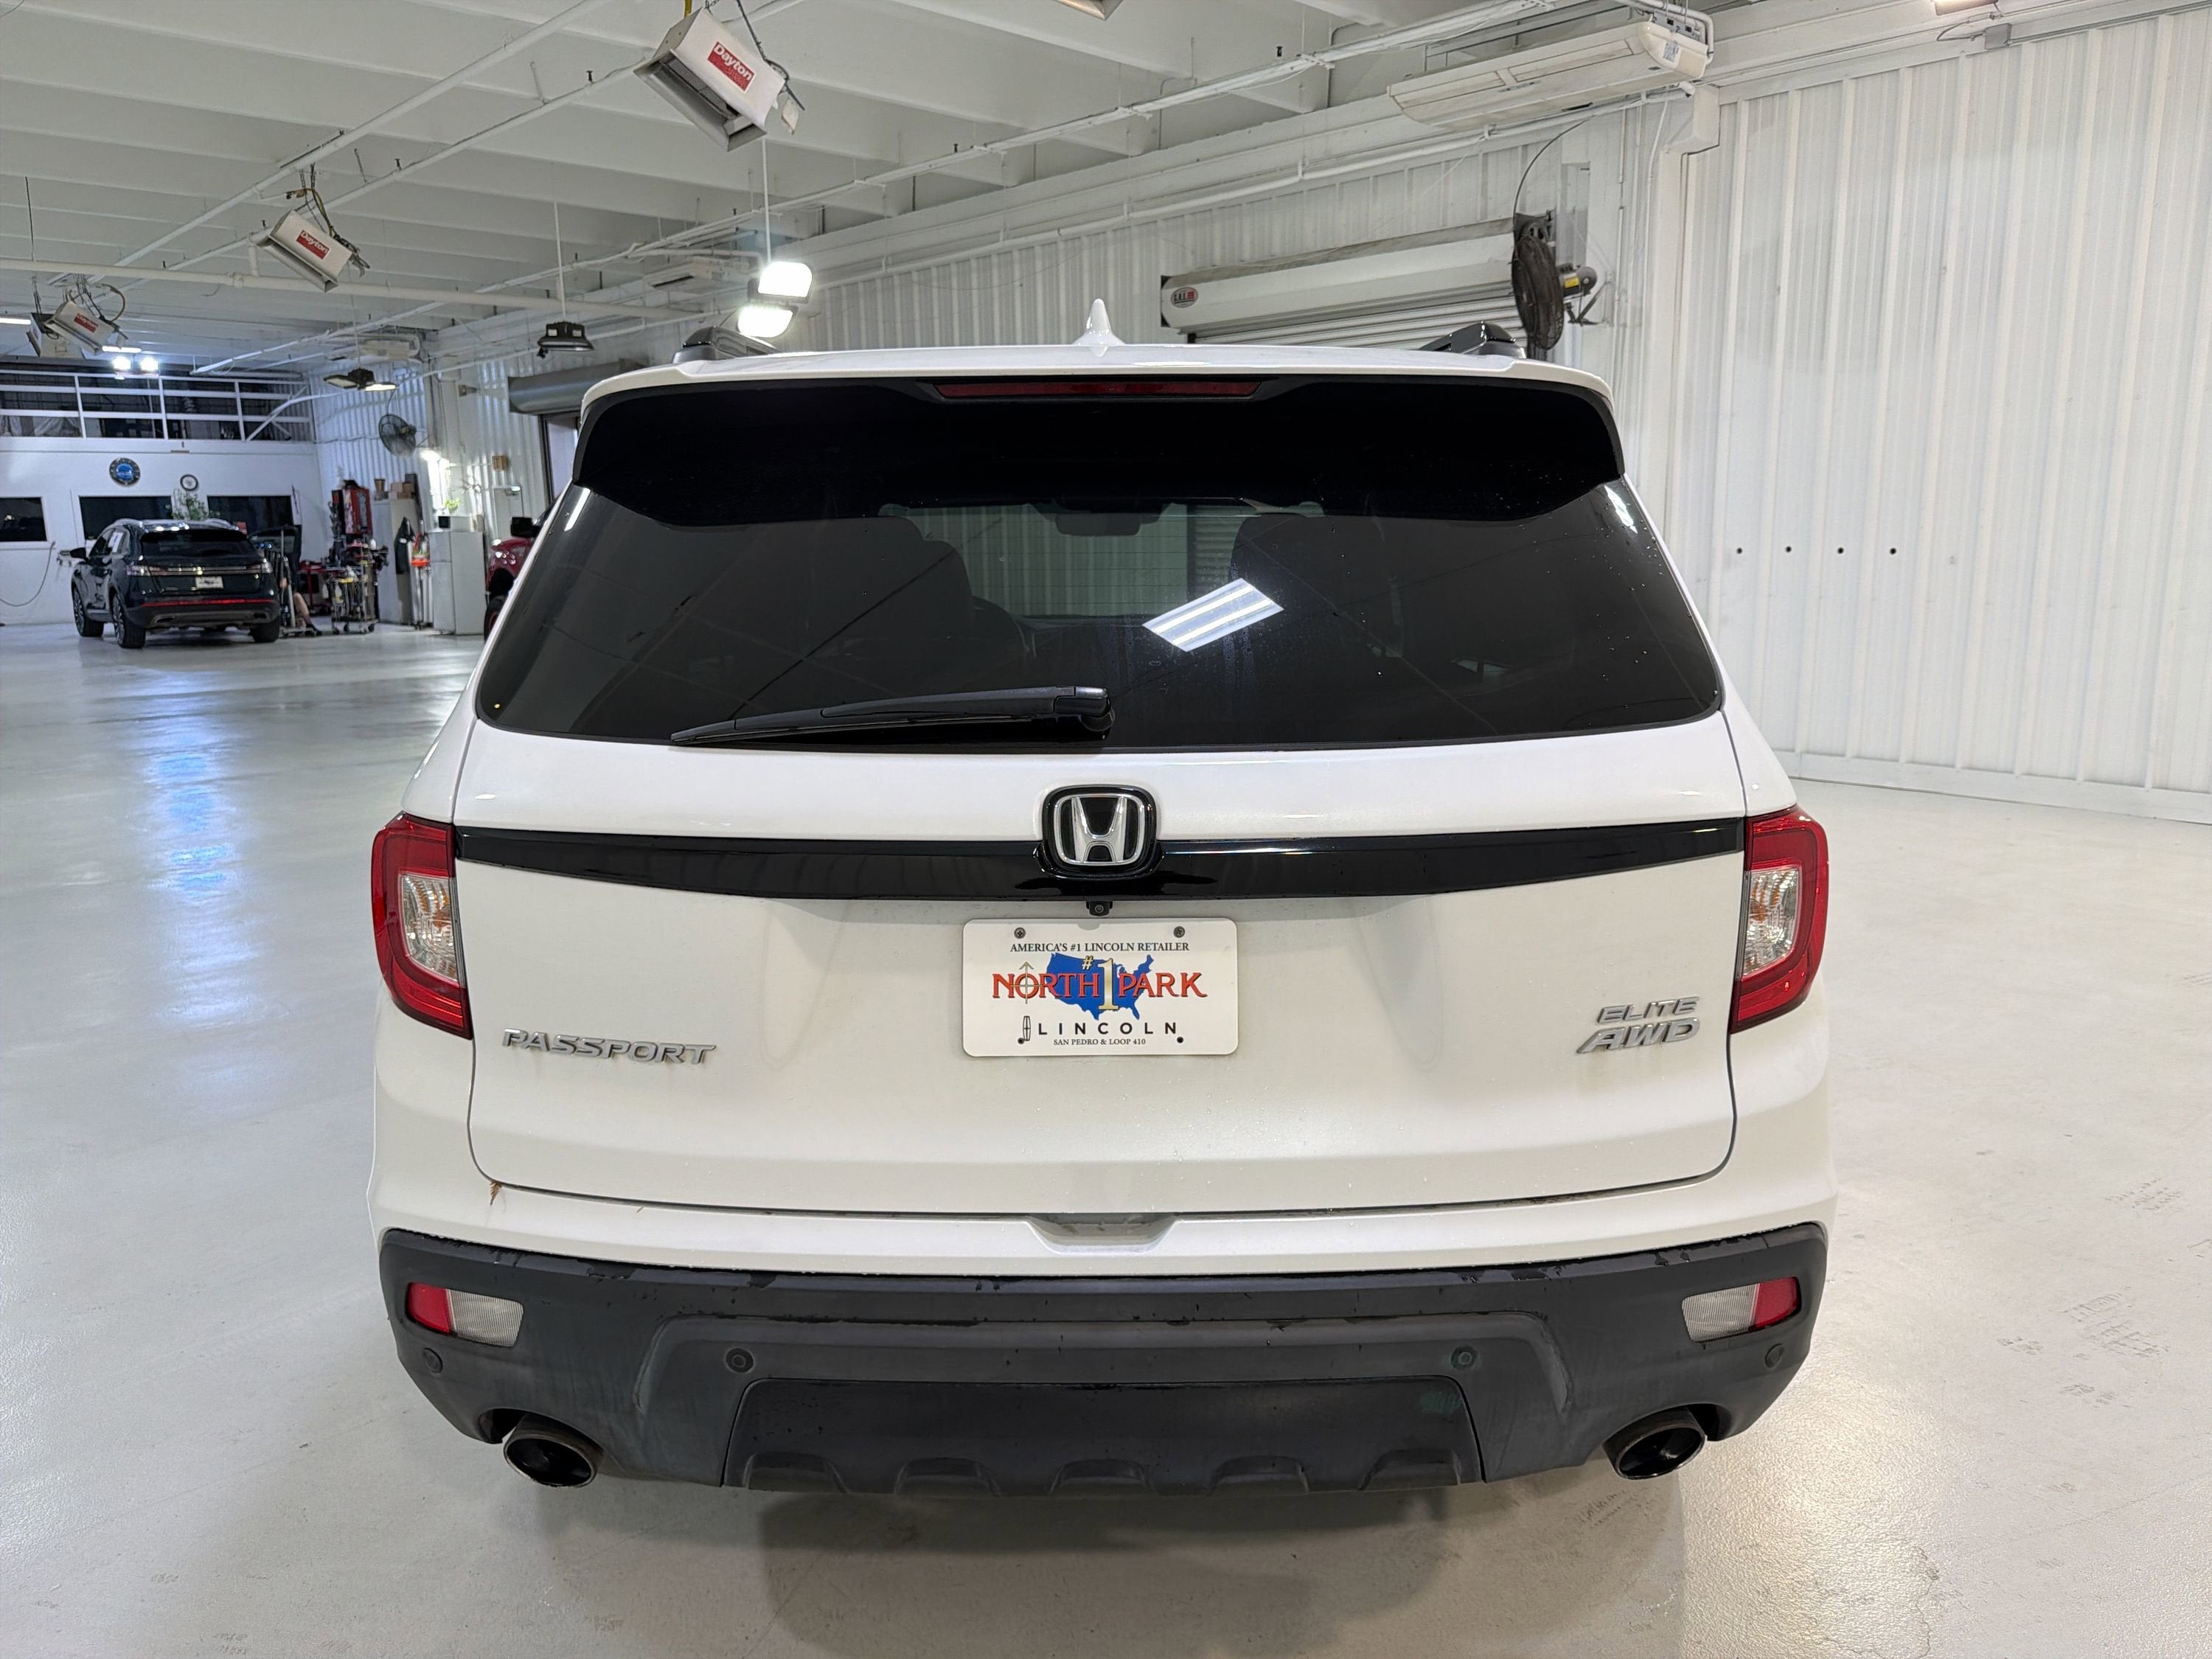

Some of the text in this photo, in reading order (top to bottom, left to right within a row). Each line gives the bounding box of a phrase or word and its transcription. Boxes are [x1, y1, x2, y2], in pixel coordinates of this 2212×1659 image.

[713, 44, 752, 81] Dayton
[301, 232, 329, 253] Dayton
[1010, 942, 1190, 952] AMERICA'S #1 LINCOLN RETAILER
[992, 973, 1208, 998] NORTH PARK
[1597, 996, 1700, 1024] ELITE
[1038, 1022, 1176, 1035] LINCOLN
[1576, 1017, 1700, 1054] AWD
[501, 1028, 717, 1064] PASSPORT
